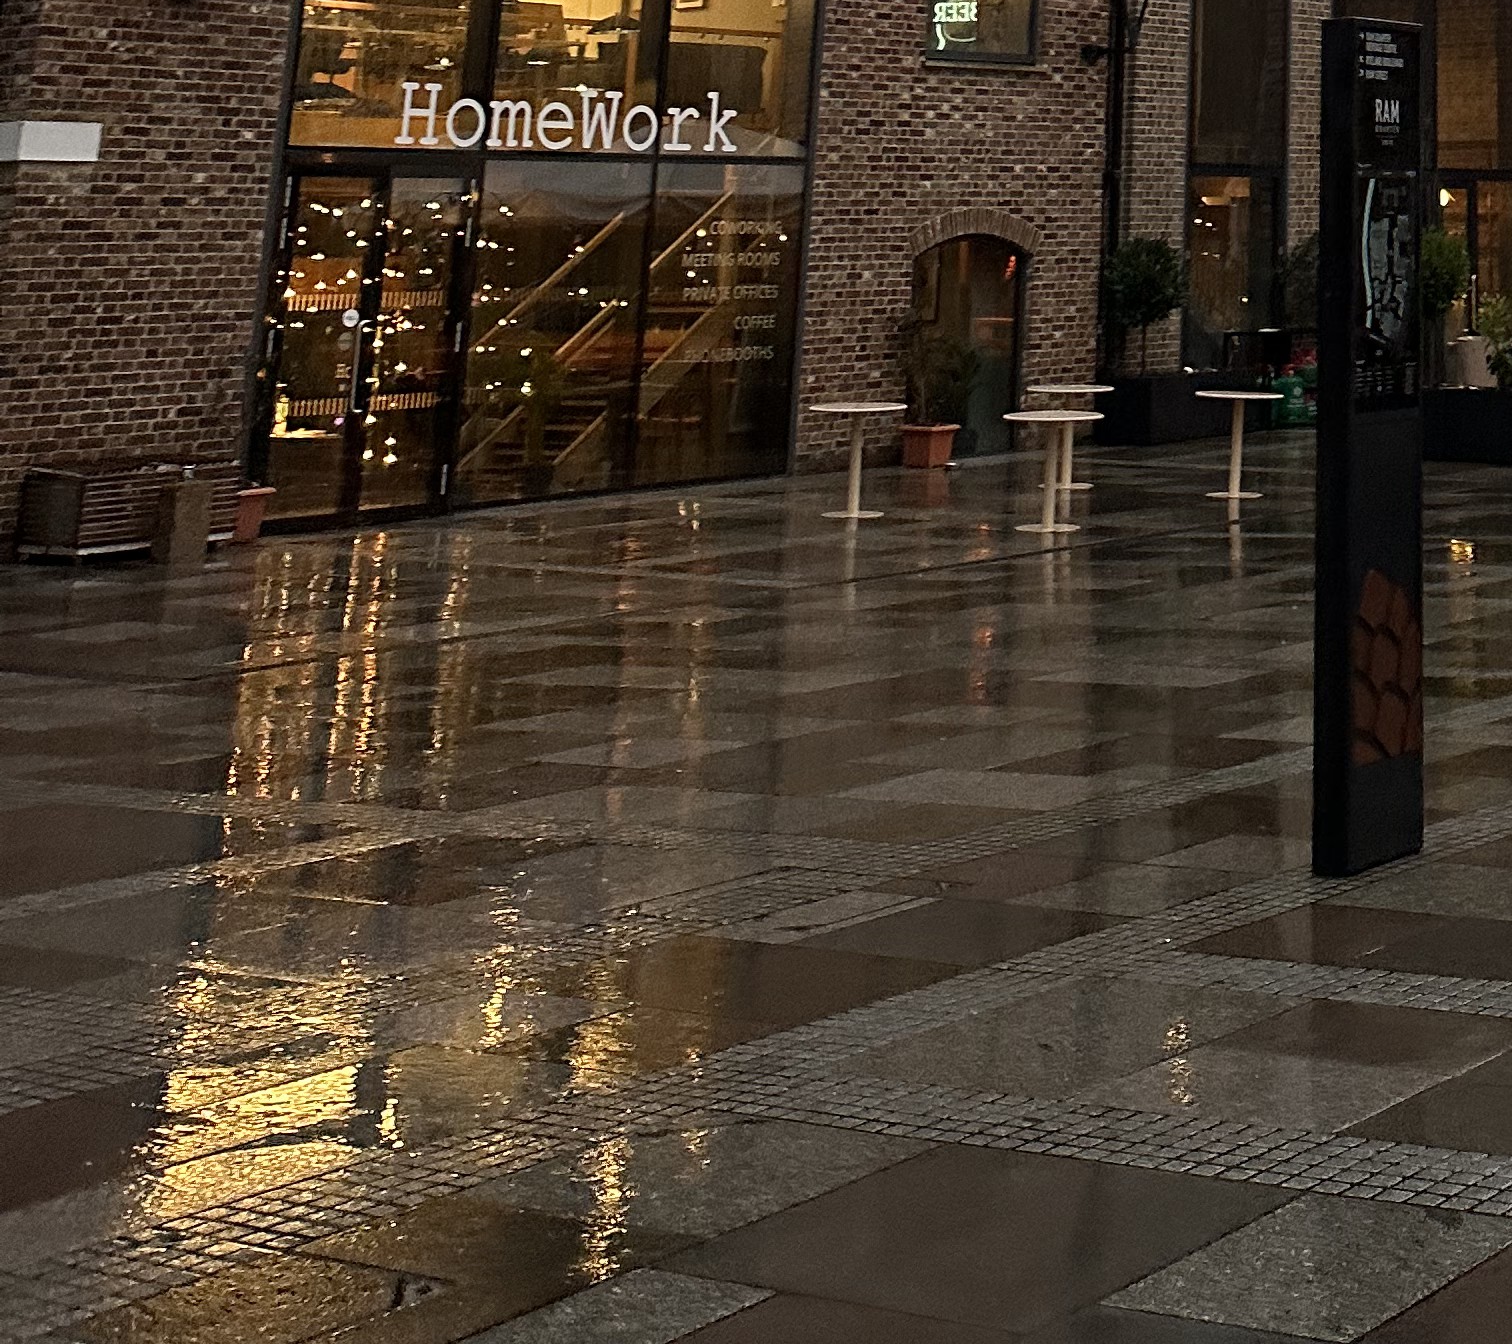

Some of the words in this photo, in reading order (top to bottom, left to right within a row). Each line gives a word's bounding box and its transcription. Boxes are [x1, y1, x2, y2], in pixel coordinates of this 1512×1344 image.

[394, 81, 738, 152] HomeWork
[1374, 98, 1400, 124] RAM
[709, 220, 783, 235] COWORKING
[681, 252, 735, 268] MEETING
[736, 251, 781, 266] ROOMS
[682, 286, 732, 301] PRIVATE
[732, 285, 779, 299] OFFICES
[734, 314, 777, 330] COFFEE
